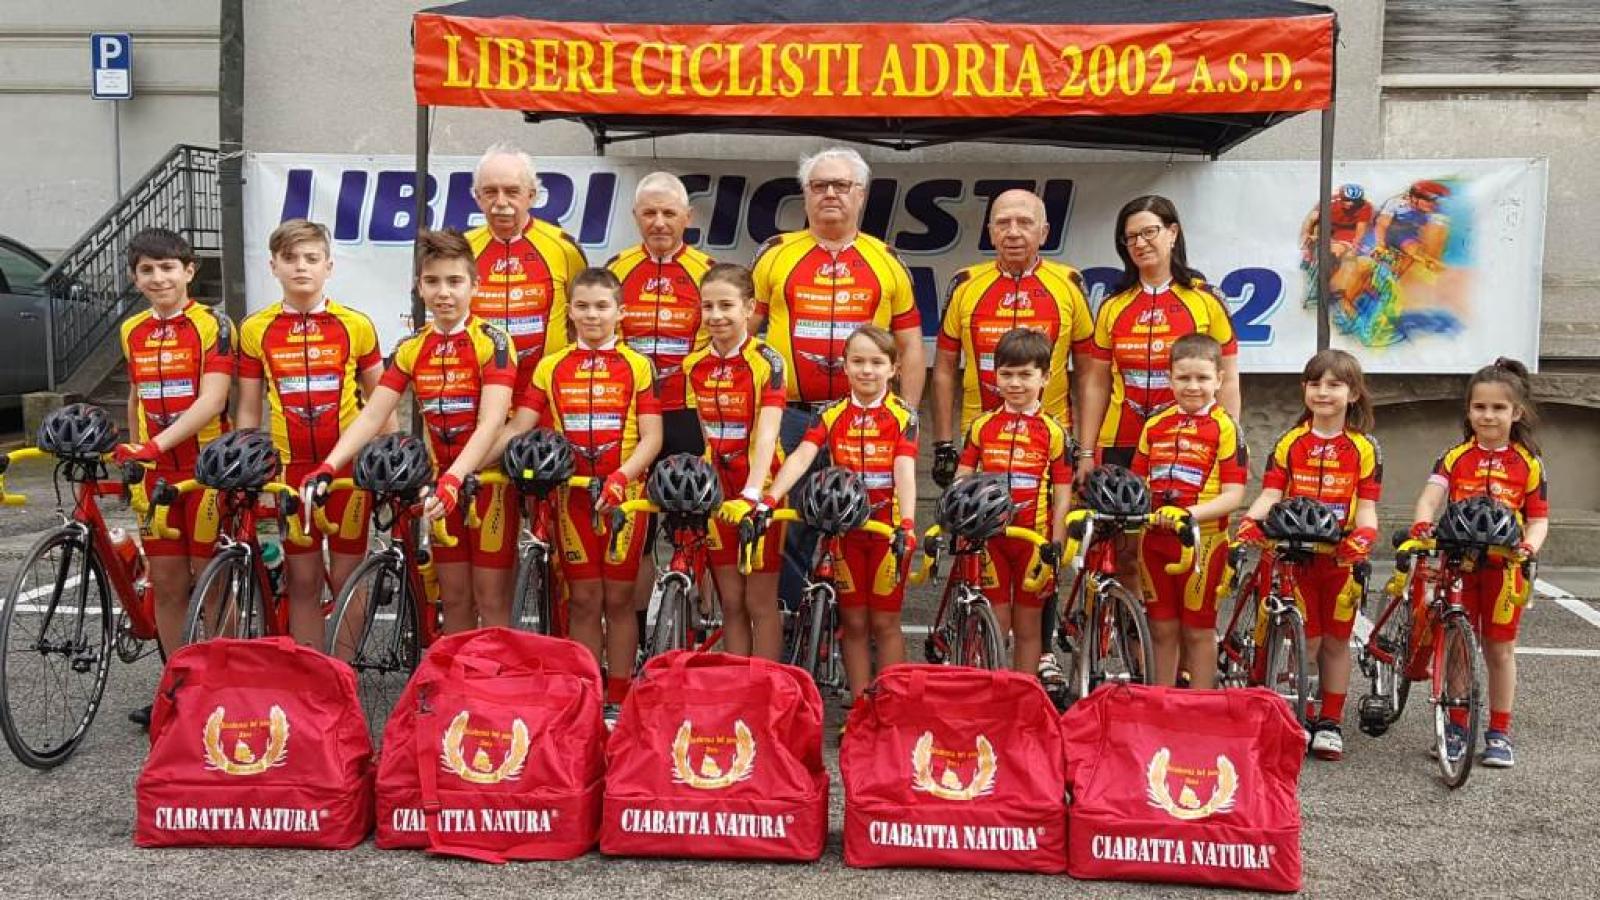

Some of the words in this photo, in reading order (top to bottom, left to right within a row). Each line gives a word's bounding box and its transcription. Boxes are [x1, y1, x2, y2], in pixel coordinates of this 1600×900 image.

[100, 37, 122, 68] P
[442, 33, 617, 95] LIBERI
[631, 41, 864, 97] CICLISTI
[873, 43, 1048, 97] ADRIA
[1059, 43, 1177, 97] 2002
[1187, 52, 1303, 93] A.S.D.
[155, 807, 244, 830] CIABATTA
[621, 808, 710, 836] CIABATTA
[869, 820, 959, 848] CIABATTA
[1091, 835, 1187, 864] CIABATTA
